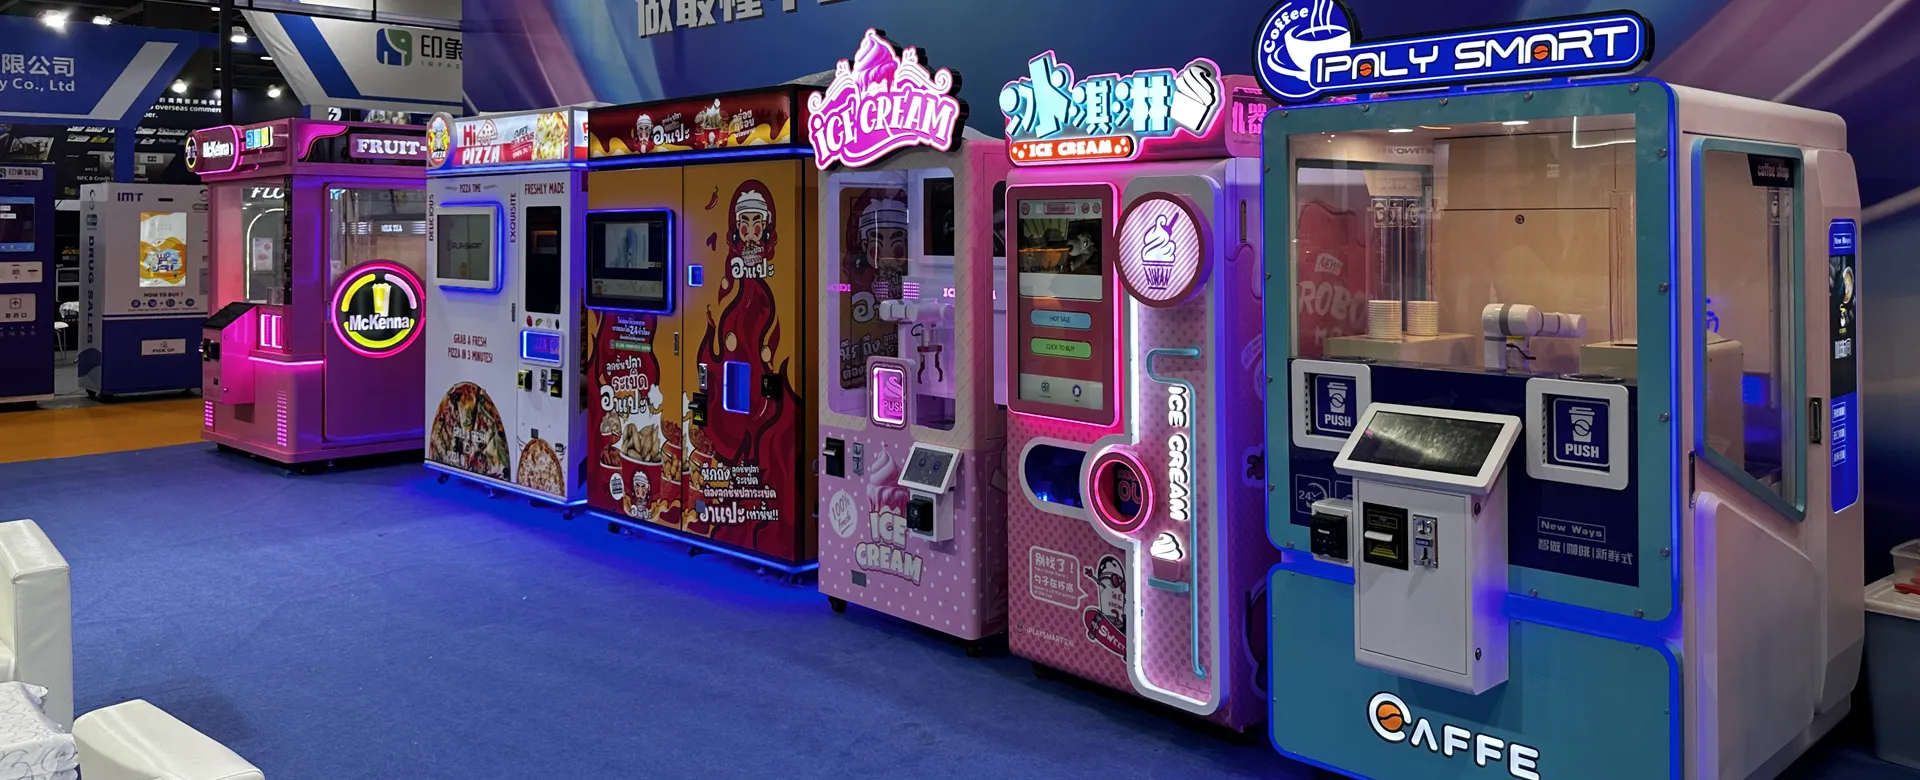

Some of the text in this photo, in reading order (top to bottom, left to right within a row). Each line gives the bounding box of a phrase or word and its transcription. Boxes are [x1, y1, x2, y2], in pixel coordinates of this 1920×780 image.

[1263, 7, 1309, 53] Coffee
[1, 53, 75, 77] 限公司
[1316, 25, 1629, 84] IPALY SMART
[12, 77, 44, 92] Co.,
[49, 79, 75, 92] Ltd
[155, 104, 188, 112] overseas
[999, 57, 1170, 139] 冰淇淋
[860, 89, 954, 141] CREAM
[463, 124, 476, 147] Hi
[652, 123, 690, 146] อาแปะ
[462, 145, 501, 165] PIZZA
[1028, 139, 1113, 158] ICE CREAM
[1757, 162, 1790, 182] coffee shop
[459, 183, 482, 193] PIZZA TIME
[524, 182, 565, 195] FRESHLY MADE
[509, 192, 517, 243] EXQUISITE
[87, 235, 95, 284] DRUG
[730, 256, 775, 279] อาแปะ
[1299, 280, 1367, 329] ROBO
[86, 290, 94, 344] SALES
[348, 314, 410, 331] McKenna
[453, 333, 487, 347] GRAB A FRESH
[1045, 343, 1058, 351] CLICK
[447, 346, 493, 363] PIZZA IN 3 MINUTES!
[606, 354, 642, 376] ลูกชิ้นปลา
[600, 384, 648, 415] อาแปะ
[1324, 413, 1352, 428] PUSH
[1168, 385, 1189, 521] ICE CREAM
[1565, 442, 1600, 459] PUSH
[701, 462, 731, 481] นึกถึง
[869, 511, 908, 549] ICE
[1541, 520, 1603, 538] New Ways
[855, 542, 923, 586] CREAM
[1368, 691, 1540, 780] CAFFE
